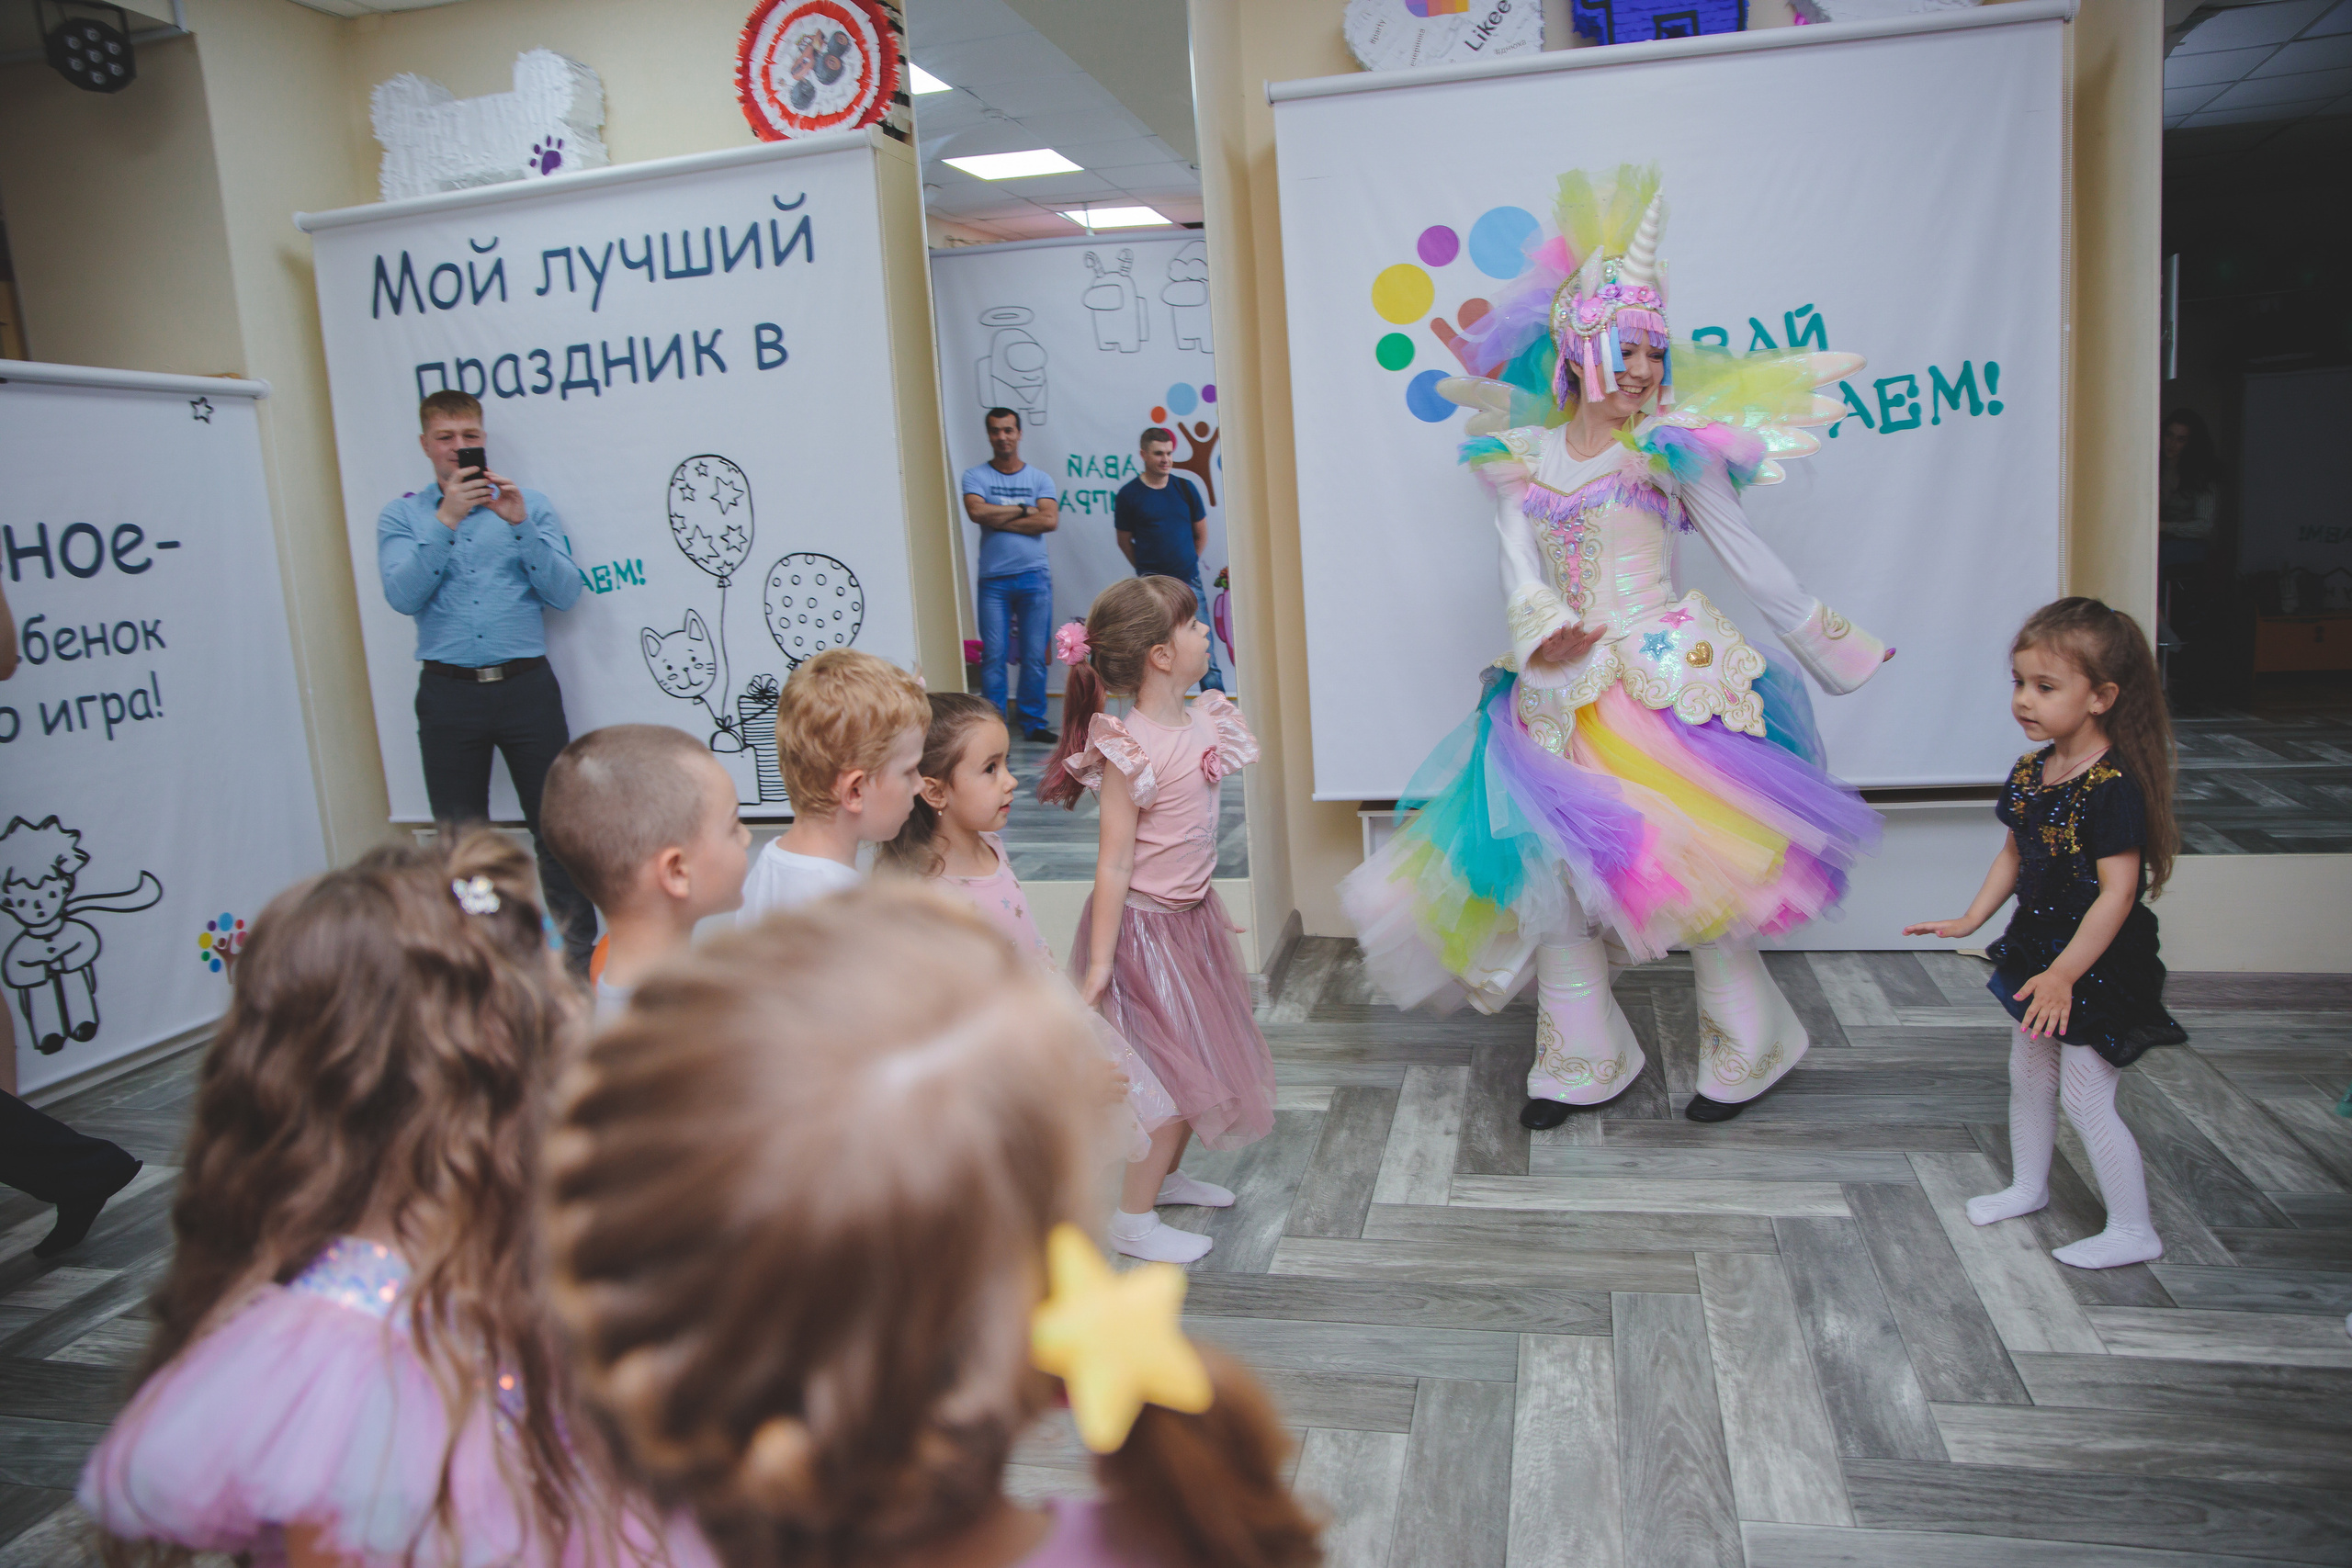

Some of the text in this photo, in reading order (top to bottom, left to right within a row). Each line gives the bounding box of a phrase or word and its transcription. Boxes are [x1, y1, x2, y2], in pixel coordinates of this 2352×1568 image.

[1369, 18, 1387, 45] #party
[1409, 28, 1426, 67] ечеринка
[1464, 0, 1512, 51] Likee
[373, 192, 815, 320] Мой лучший
[1691, 303, 1829, 360] ВАЙ
[415, 321, 789, 401] праздник в
[1828, 360, 2005, 439] АЕМ!
[0, 522, 182, 582] ное-
[577, 558, 646, 595] АЕМ!
[17, 613, 167, 666] бенок
[39, 671, 164, 742] игра!
